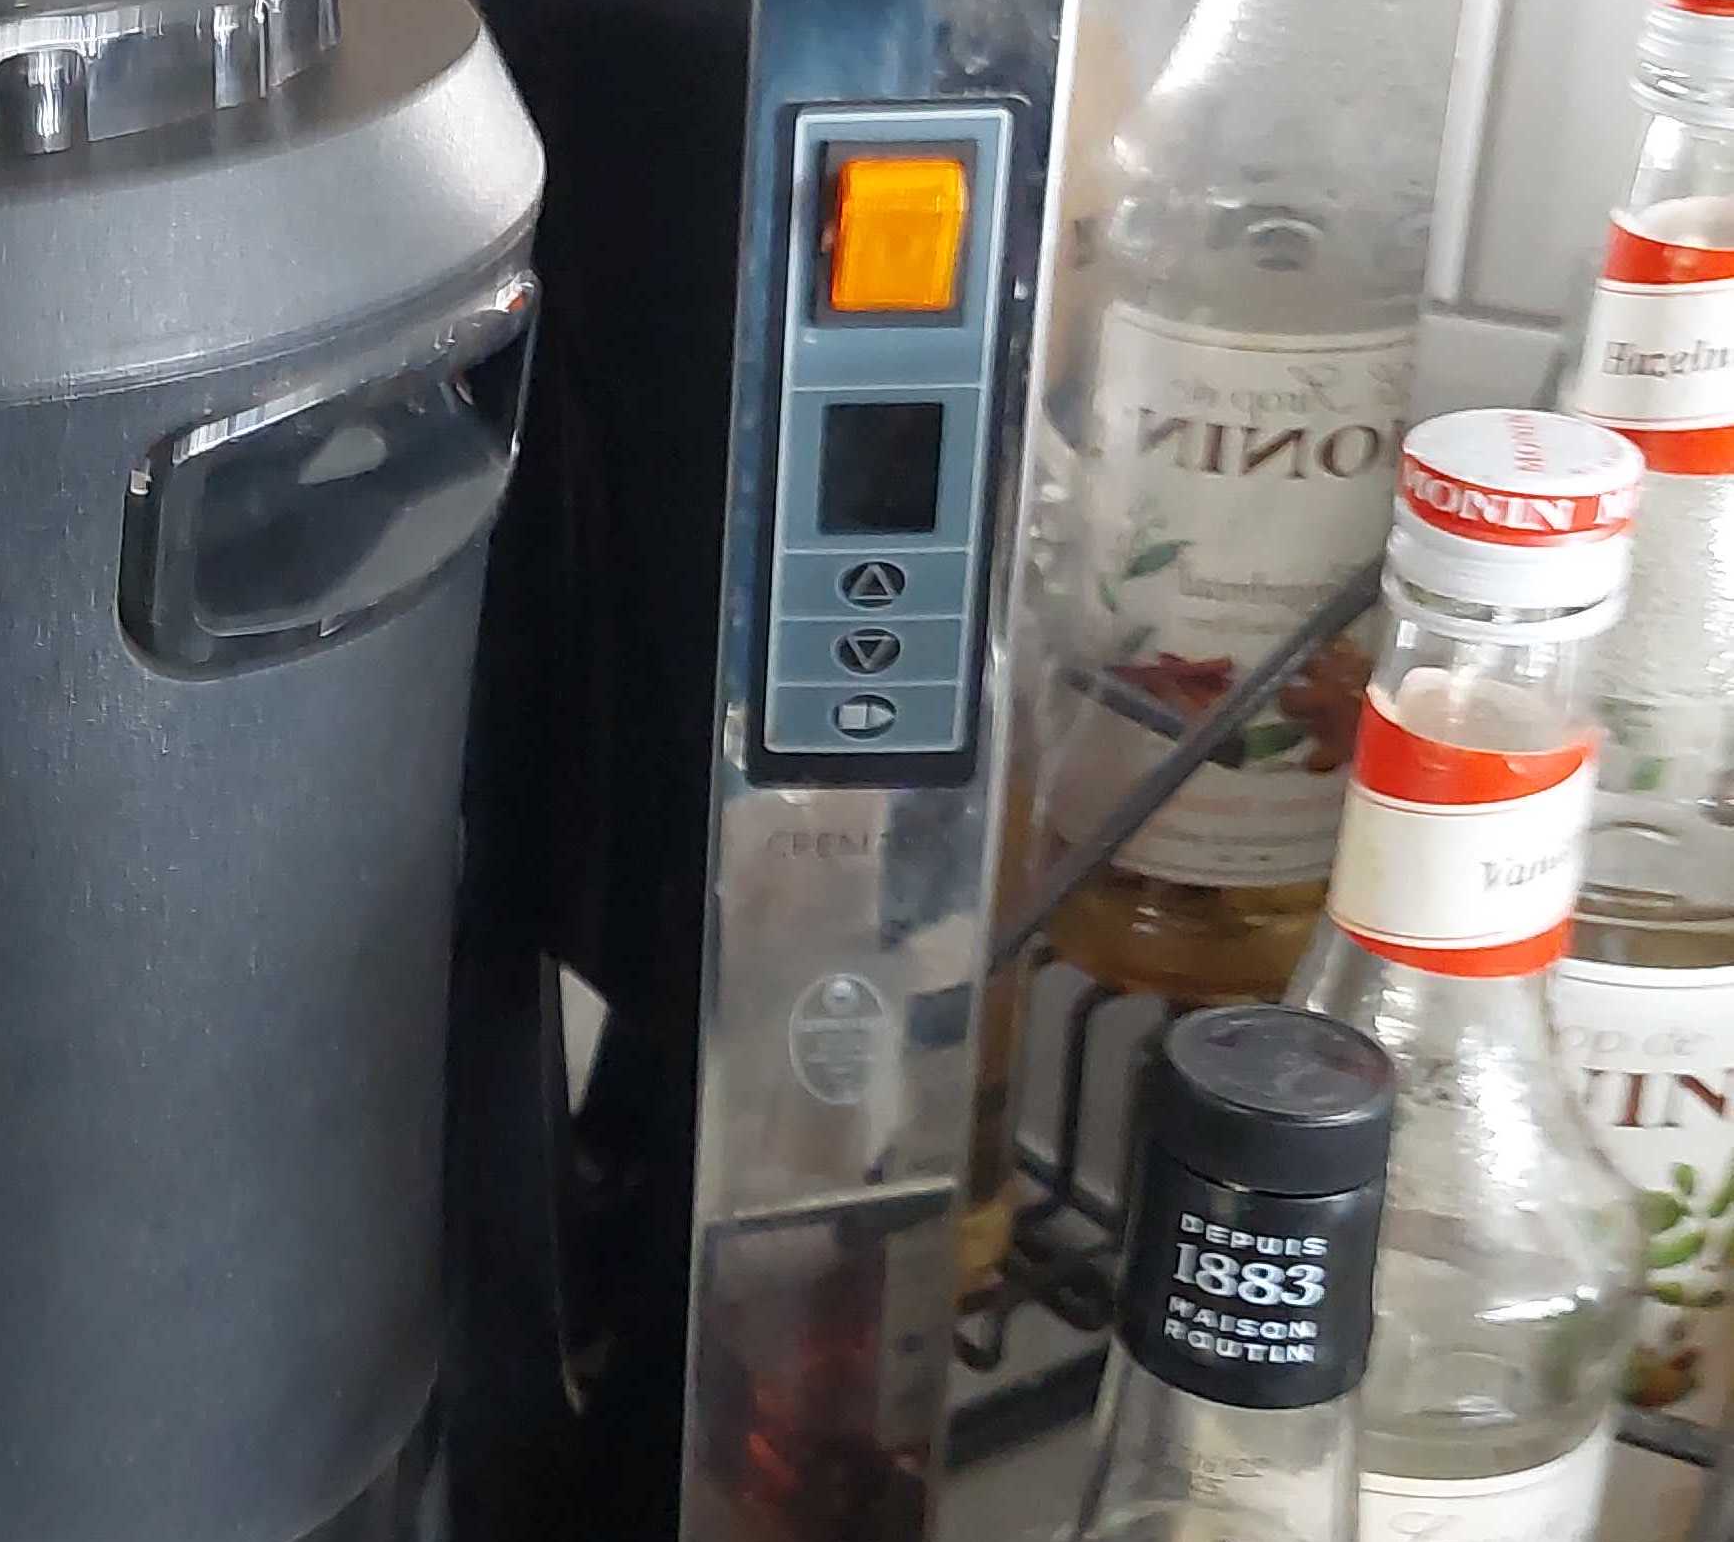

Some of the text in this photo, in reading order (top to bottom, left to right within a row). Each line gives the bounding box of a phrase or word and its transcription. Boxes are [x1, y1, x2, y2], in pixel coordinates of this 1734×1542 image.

[1180, 1213, 1328, 1256] DEPUIS
[1172, 1242, 1326, 1306] 1883
[1169, 1295, 1317, 1340] MAISON
[1165, 1318, 1315, 1363] ROUTIN
